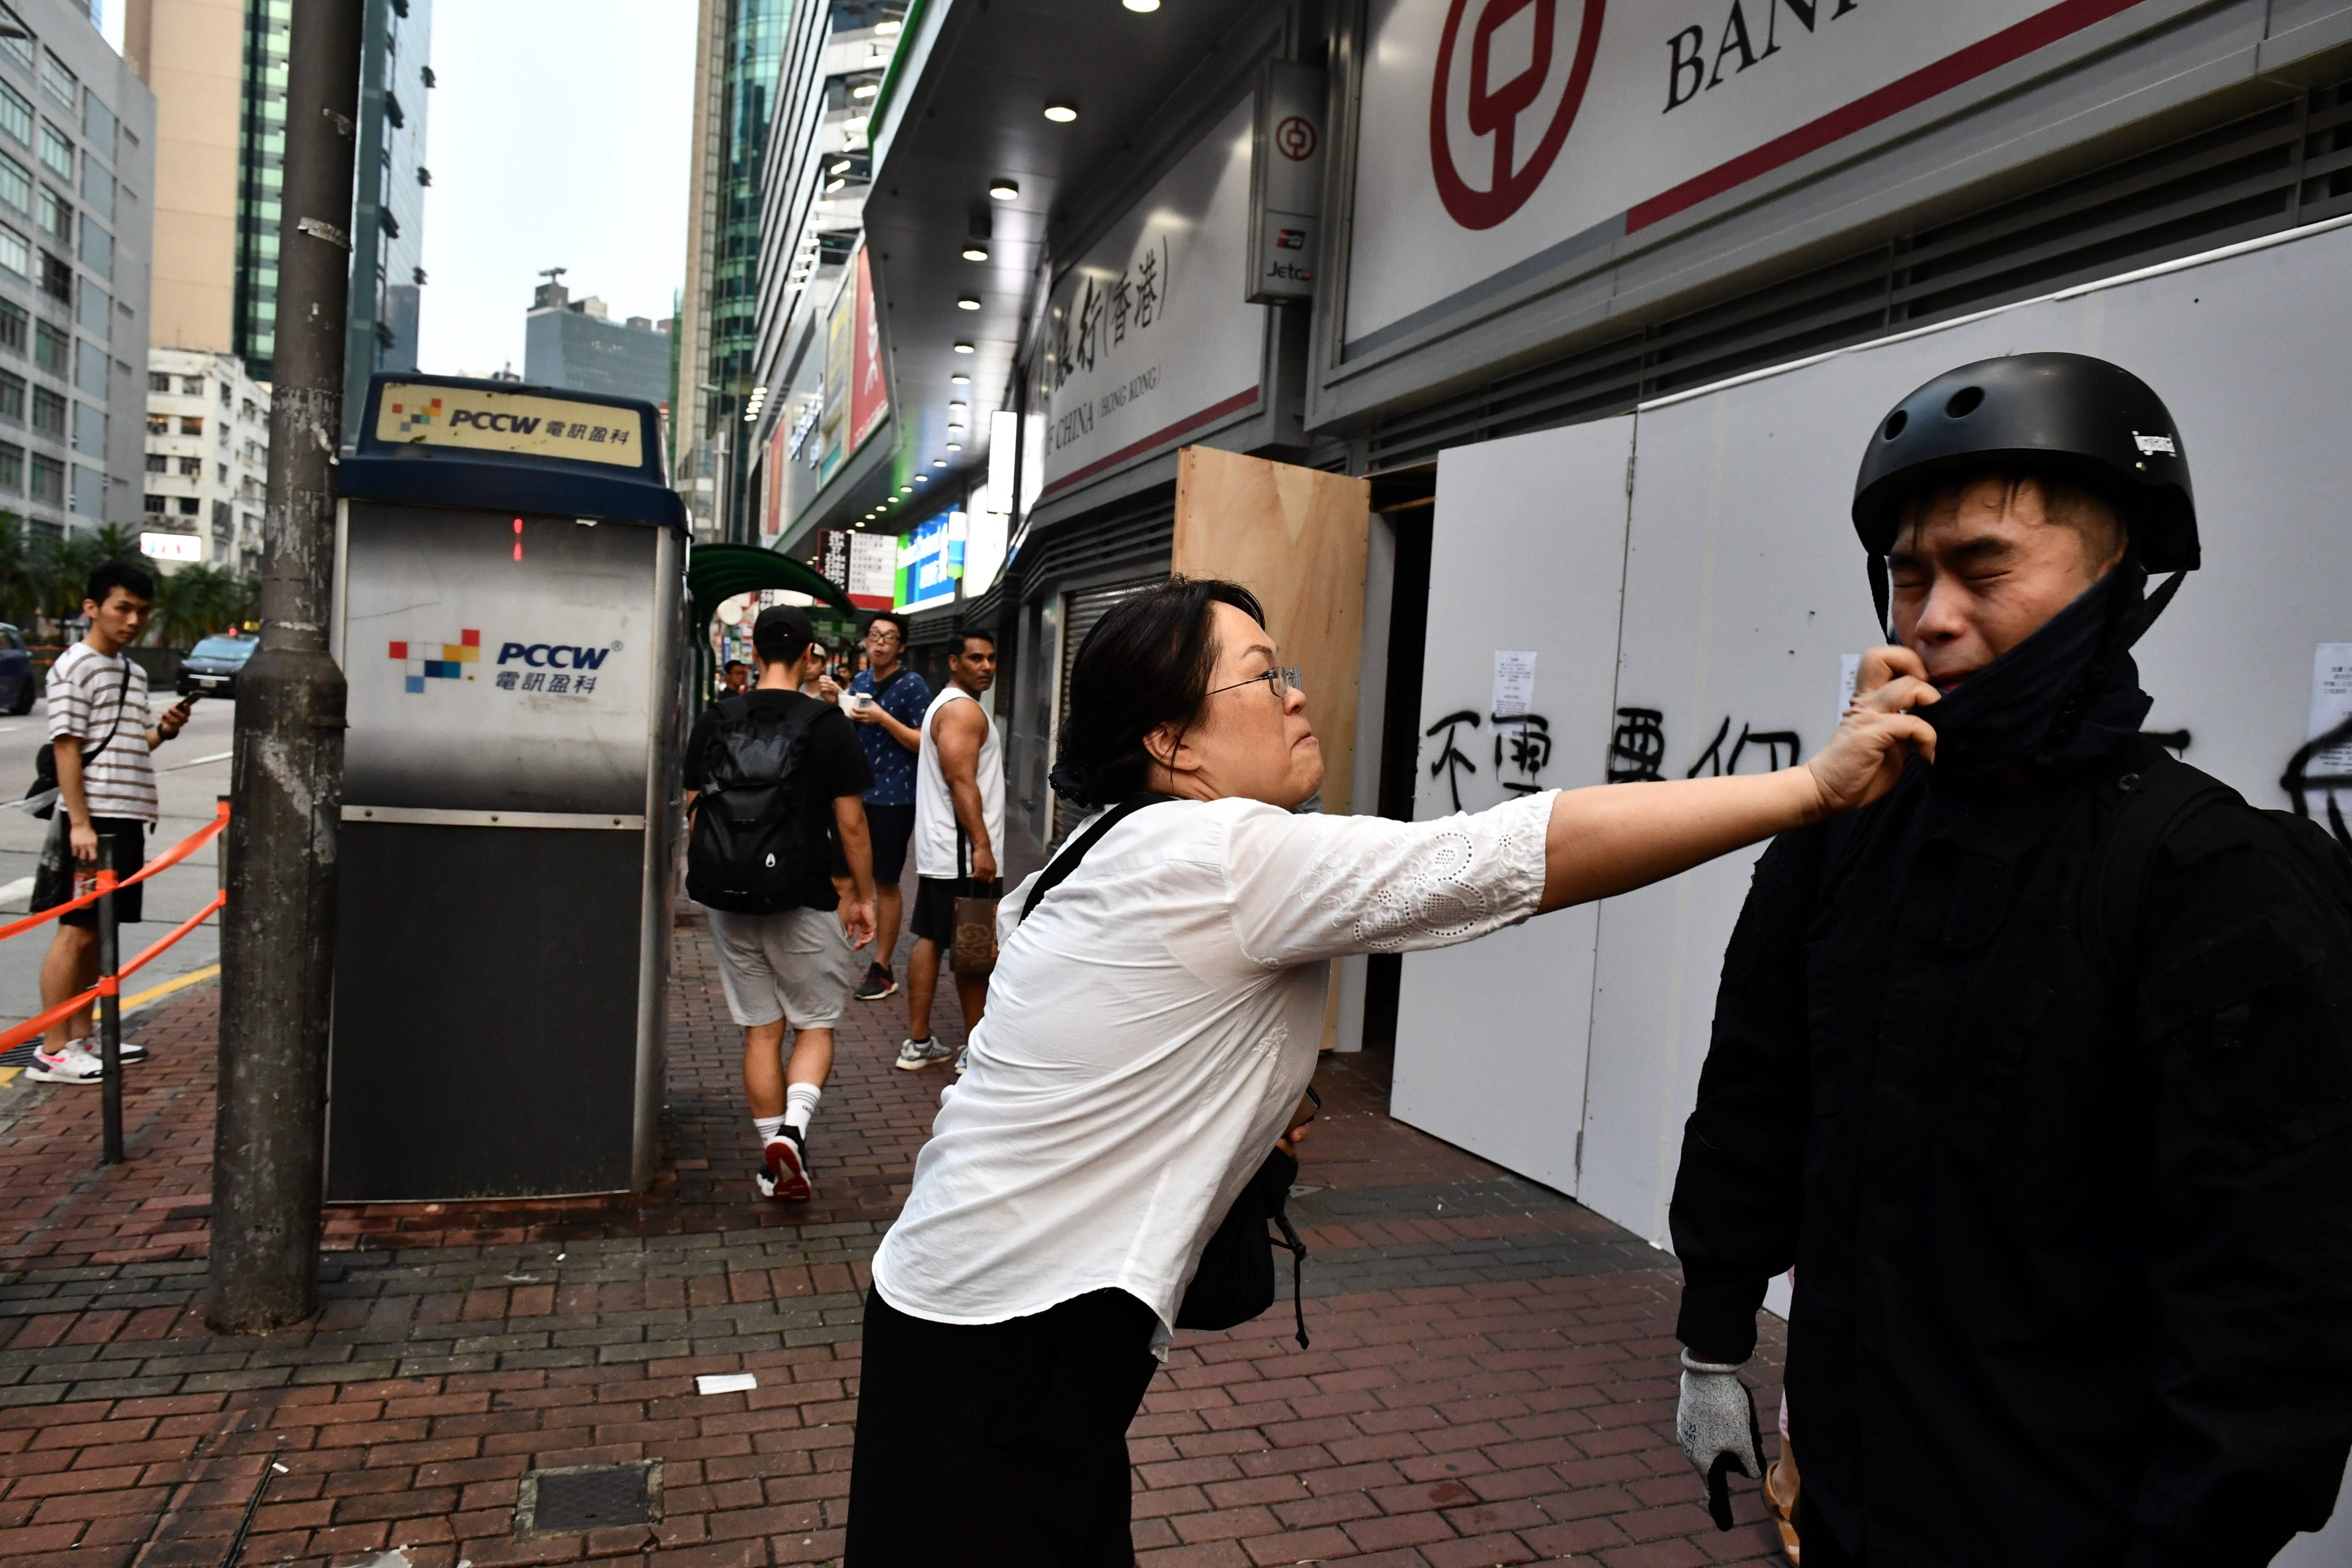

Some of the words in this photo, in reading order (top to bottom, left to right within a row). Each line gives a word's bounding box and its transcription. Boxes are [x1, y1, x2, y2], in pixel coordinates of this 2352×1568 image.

[1663, 0, 1858, 114] BAN
[449, 409, 541, 436] PCCW
[545, 420, 629, 445] 電訊盈科
[1056, 400, 1094, 449] CHINA
[495, 671, 596, 694] 電訊盈科
